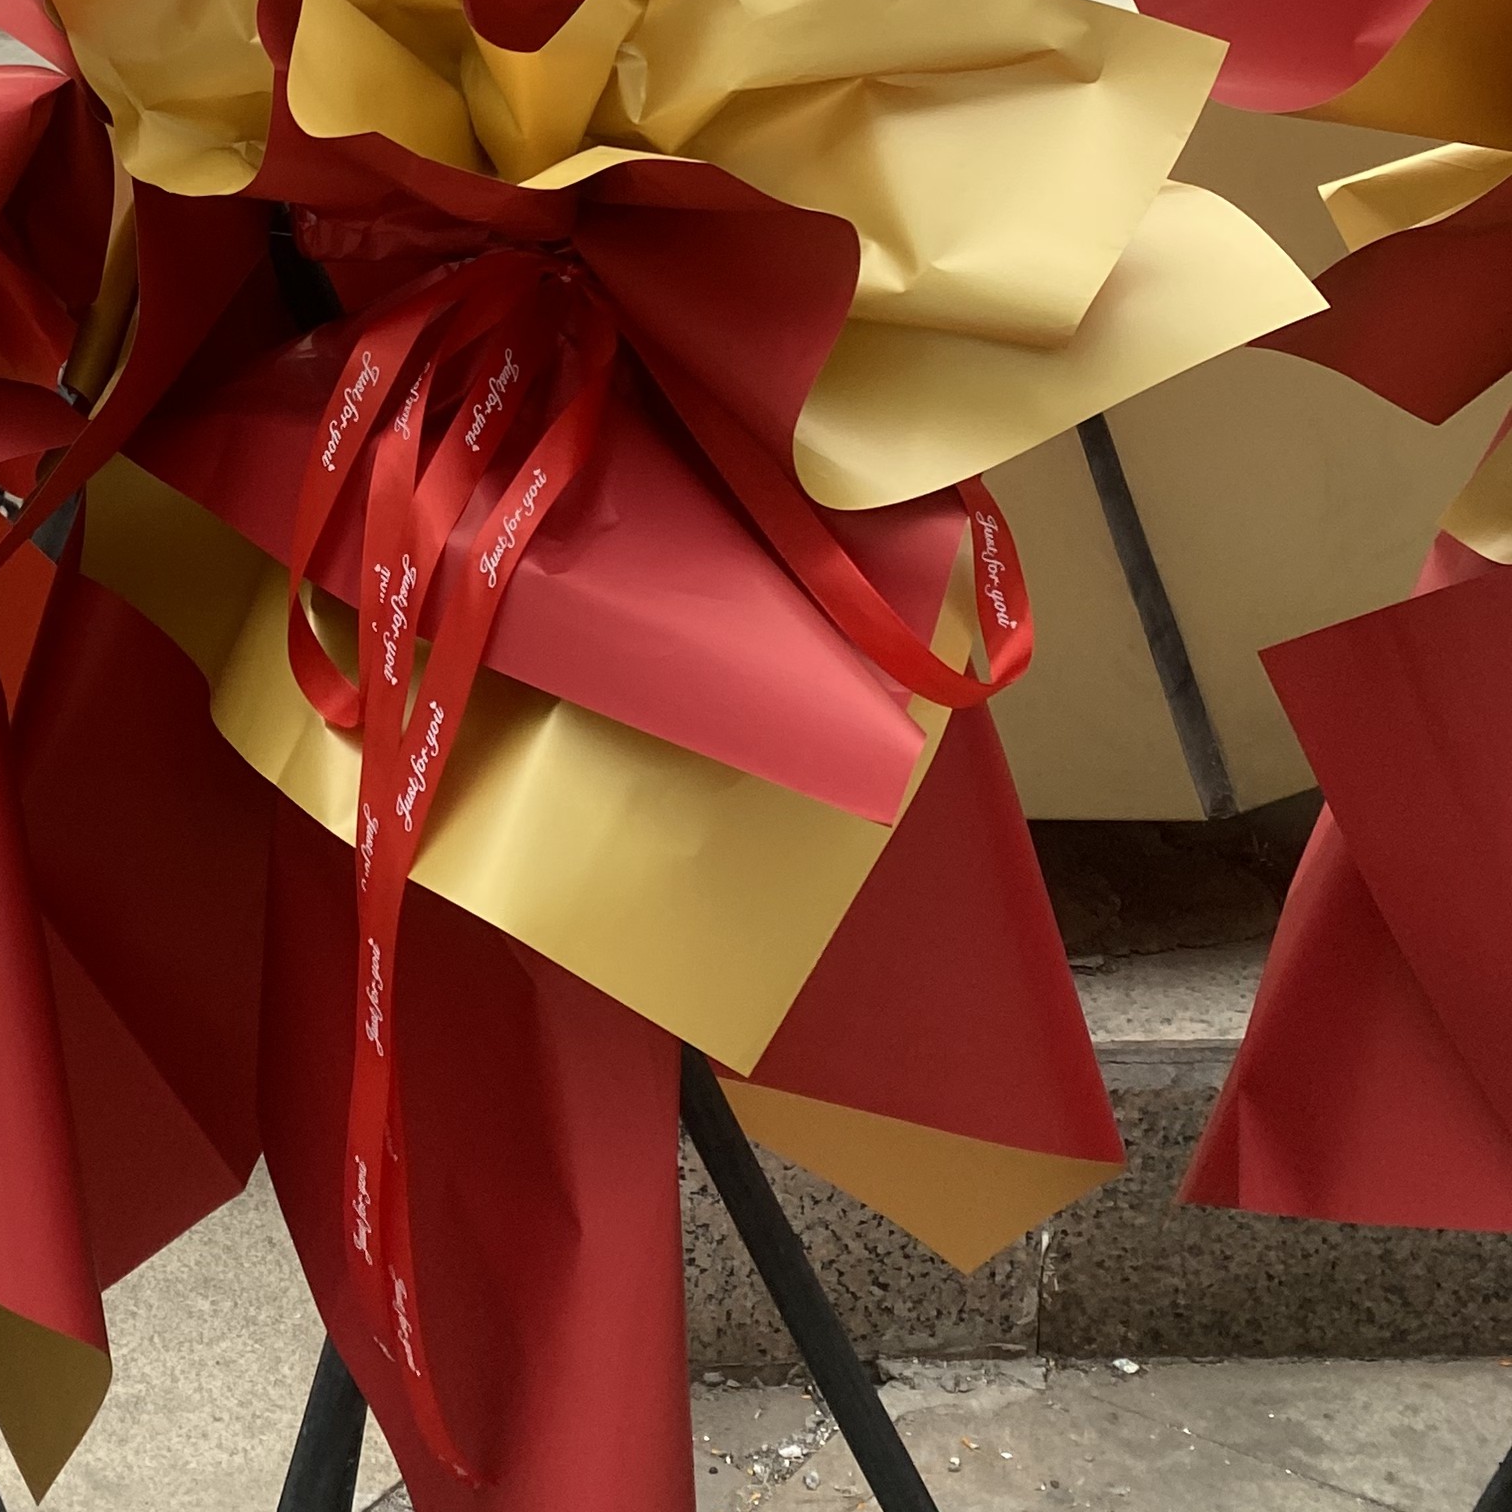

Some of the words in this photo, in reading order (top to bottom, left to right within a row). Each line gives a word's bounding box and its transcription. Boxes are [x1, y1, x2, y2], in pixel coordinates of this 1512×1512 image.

[352, 351, 380, 402] Just
[496, 348, 519, 393] Just
[976, 511, 998, 555] Just
[399, 554, 417, 608] Just
[480, 536, 508, 588] Just
[396, 777, 419, 832] Just
